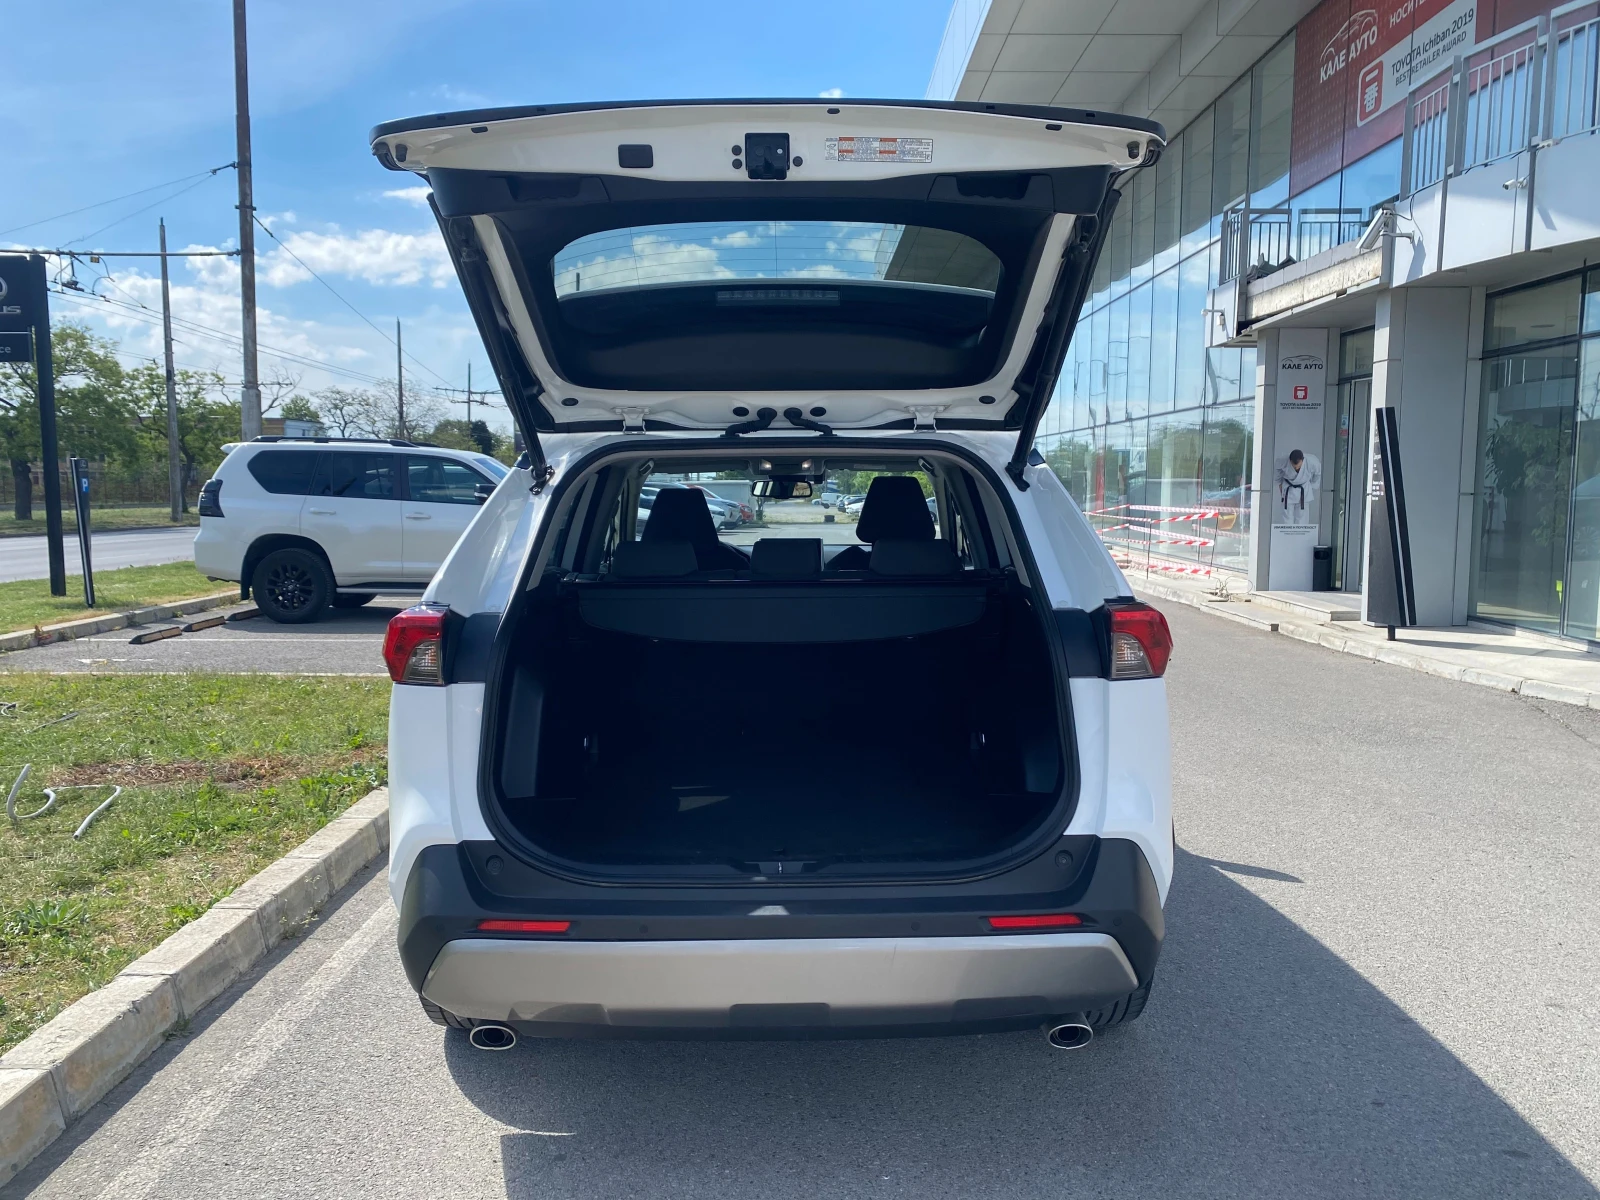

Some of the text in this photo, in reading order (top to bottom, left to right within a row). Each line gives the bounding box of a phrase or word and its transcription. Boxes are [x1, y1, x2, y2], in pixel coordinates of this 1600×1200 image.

[1320, 25, 1378, 84] КАЛЕ АУТО
[1391, 8, 1474, 76] TOYOTA Ichiban 2019
[1395, 31, 1467, 86] BEST RETAILER AWARD
[82, 478, 89, 491] P
